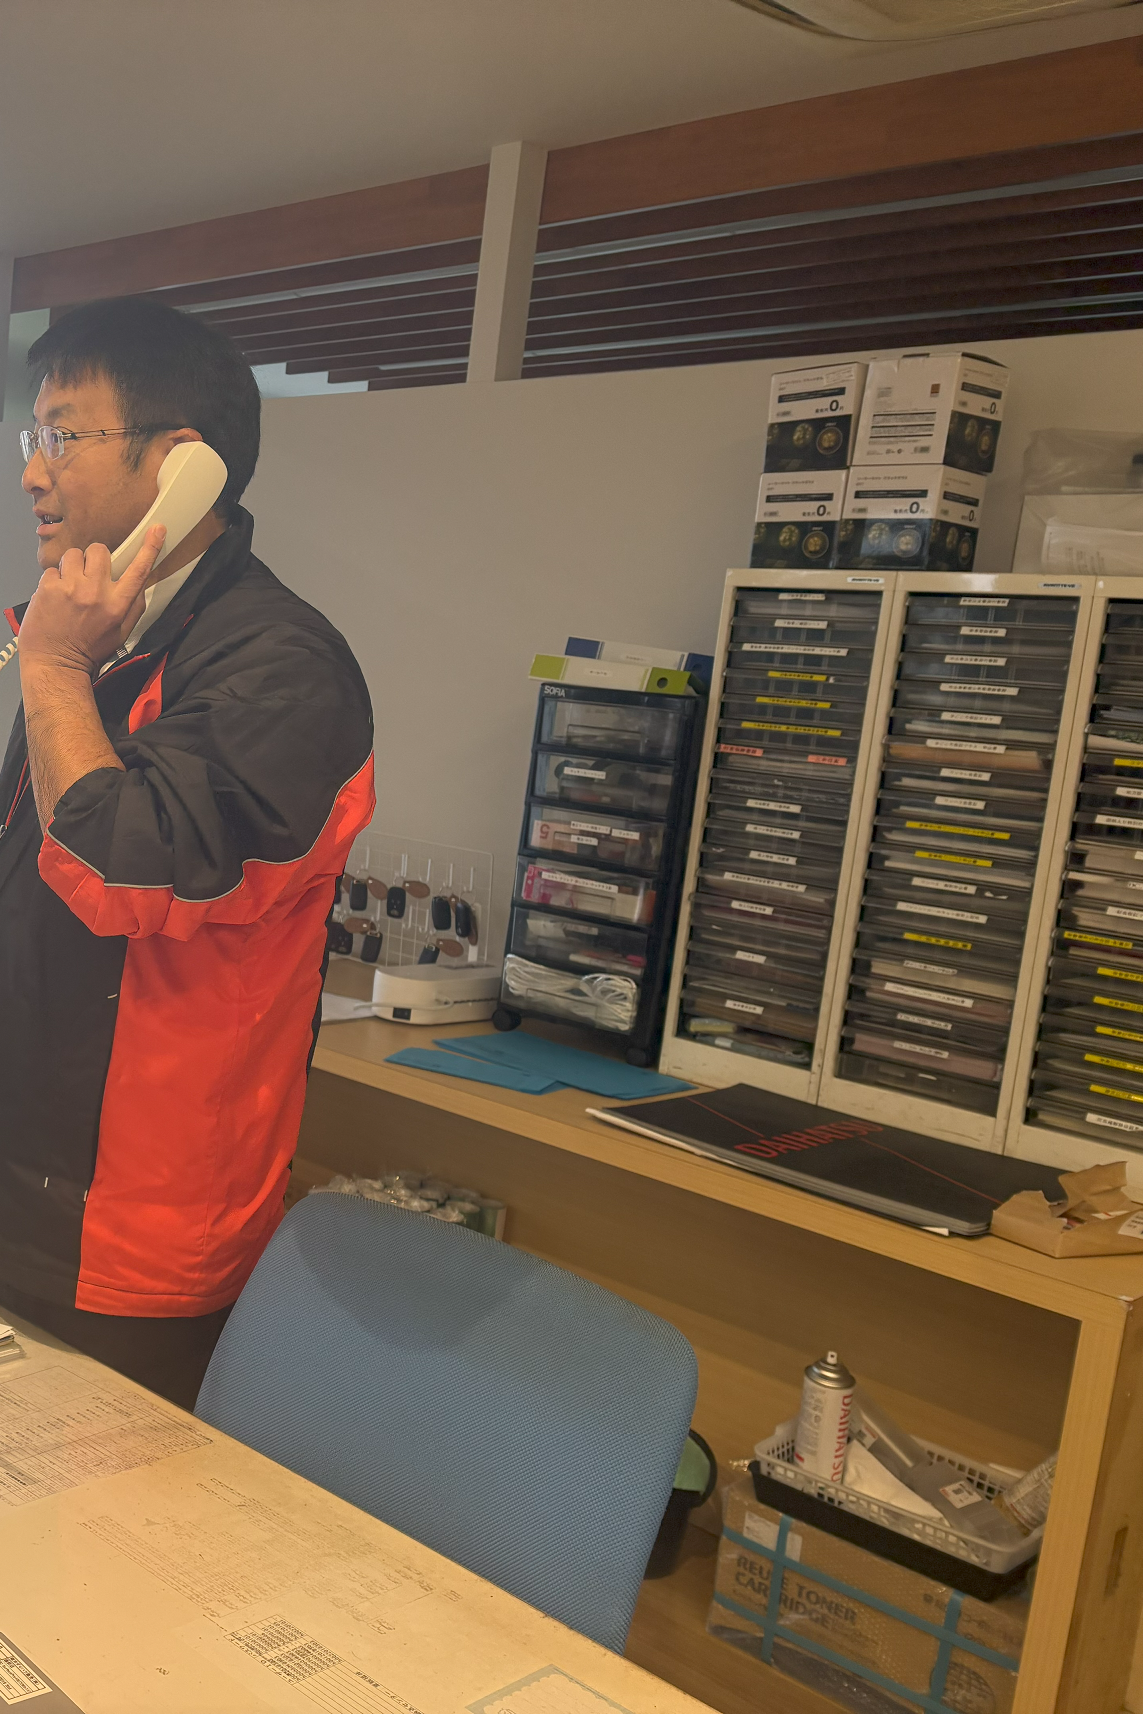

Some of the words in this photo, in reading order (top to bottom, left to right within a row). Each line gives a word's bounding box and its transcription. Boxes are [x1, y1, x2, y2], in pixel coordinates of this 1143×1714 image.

[544, 684, 566, 697] SOFIA
[734, 1119, 884, 1158] DAIHATSU
[830, 1393, 853, 1482] DAIHATSU
[735, 1555, 788, 1590] REUE
[735, 1572, 835, 1631] CARRIDGE
